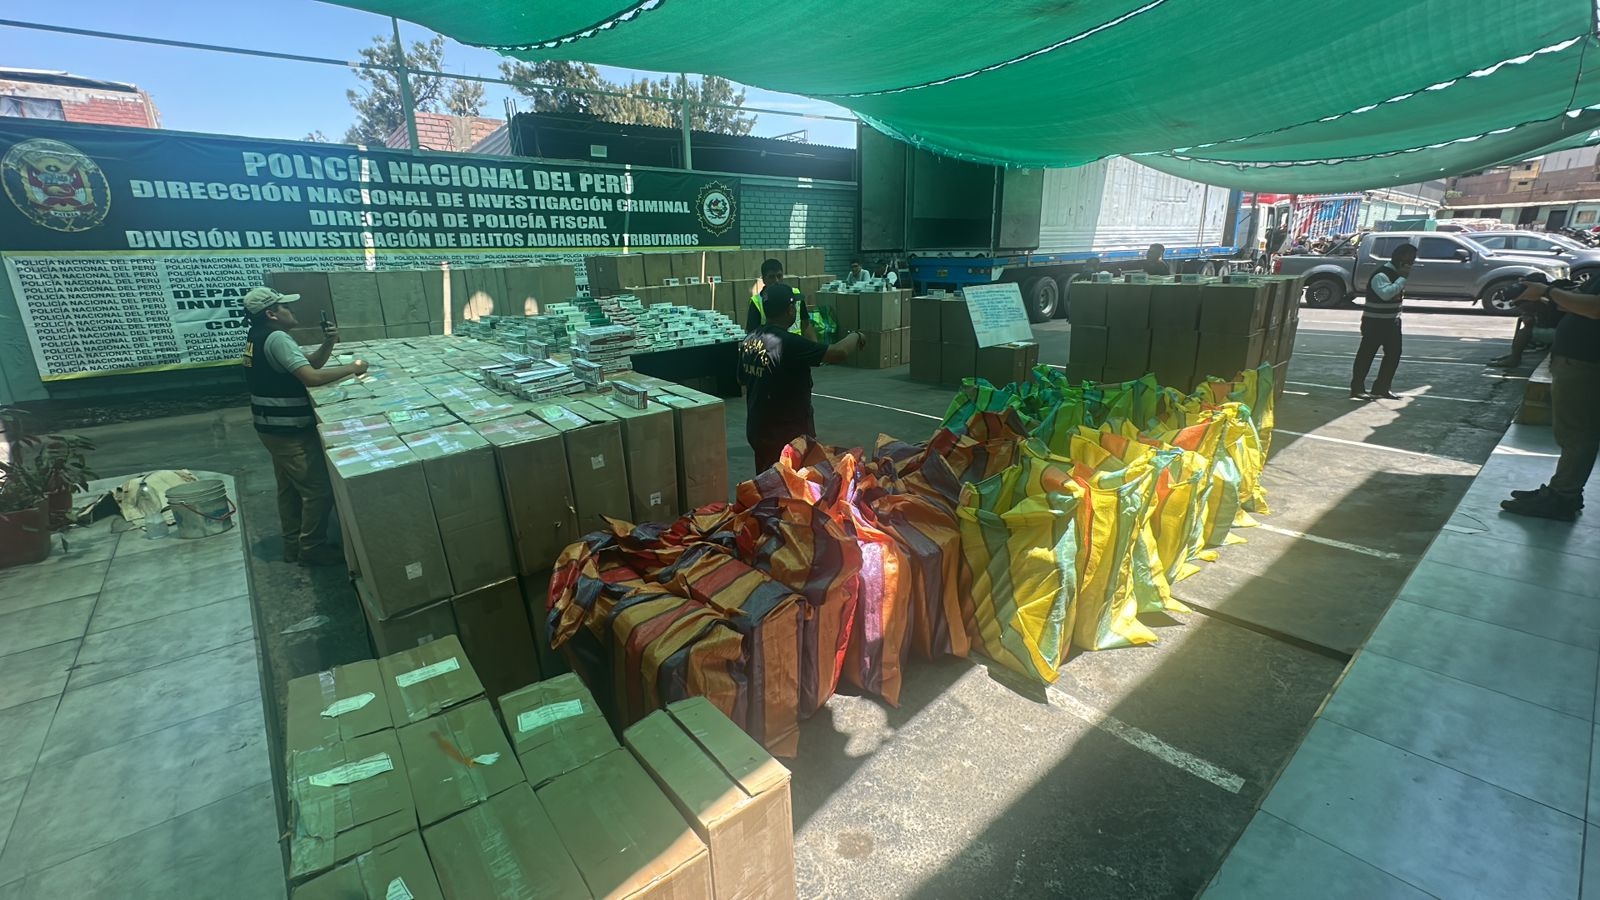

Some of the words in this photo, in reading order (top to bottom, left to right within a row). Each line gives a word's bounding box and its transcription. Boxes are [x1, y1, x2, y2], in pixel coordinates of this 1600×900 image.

[242, 151, 383, 183] POLICÍA
[388, 161, 528, 189] NACIONAL
[533, 170, 574, 192] DEL
[580, 170, 634, 194] PERÚ
[130, 180, 302, 202] DIRECCIÓN
[306, 186, 432, 206] NACIONAL
[436, 192, 464, 208] DE
[468, 195, 612, 212] INVESTIGACIÓN
[616, 198, 690, 214] CRIMINAL
[309, 210, 438, 228] DIRECCIÓN
[442, 213, 469, 228] DE
[474, 212, 547, 230] POLICÍA
[550, 216, 606, 230] FISCAL
[125, 228, 242, 248] DIVISIÓN
[246, 230, 276, 248] DE
[279, 231, 432, 248] INVESTIGACIÓN
[434, 234, 456, 248] DE
[459, 234, 526, 247] DELITOS
[528, 234, 608, 247] ADUANEROS
[612, 234, 620, 247] Y
[623, 234, 699, 246] TRIBUTARIOS
[80, 331, 128, 339] NACIONAL
[82, 337, 130, 345] NACIONAL
[84, 344, 132, 352] NACIONAL
[86, 350, 134, 358] NACIONAL
[88, 356, 136, 364] NACIONAL
[90, 362, 138, 371] NACIONAL
